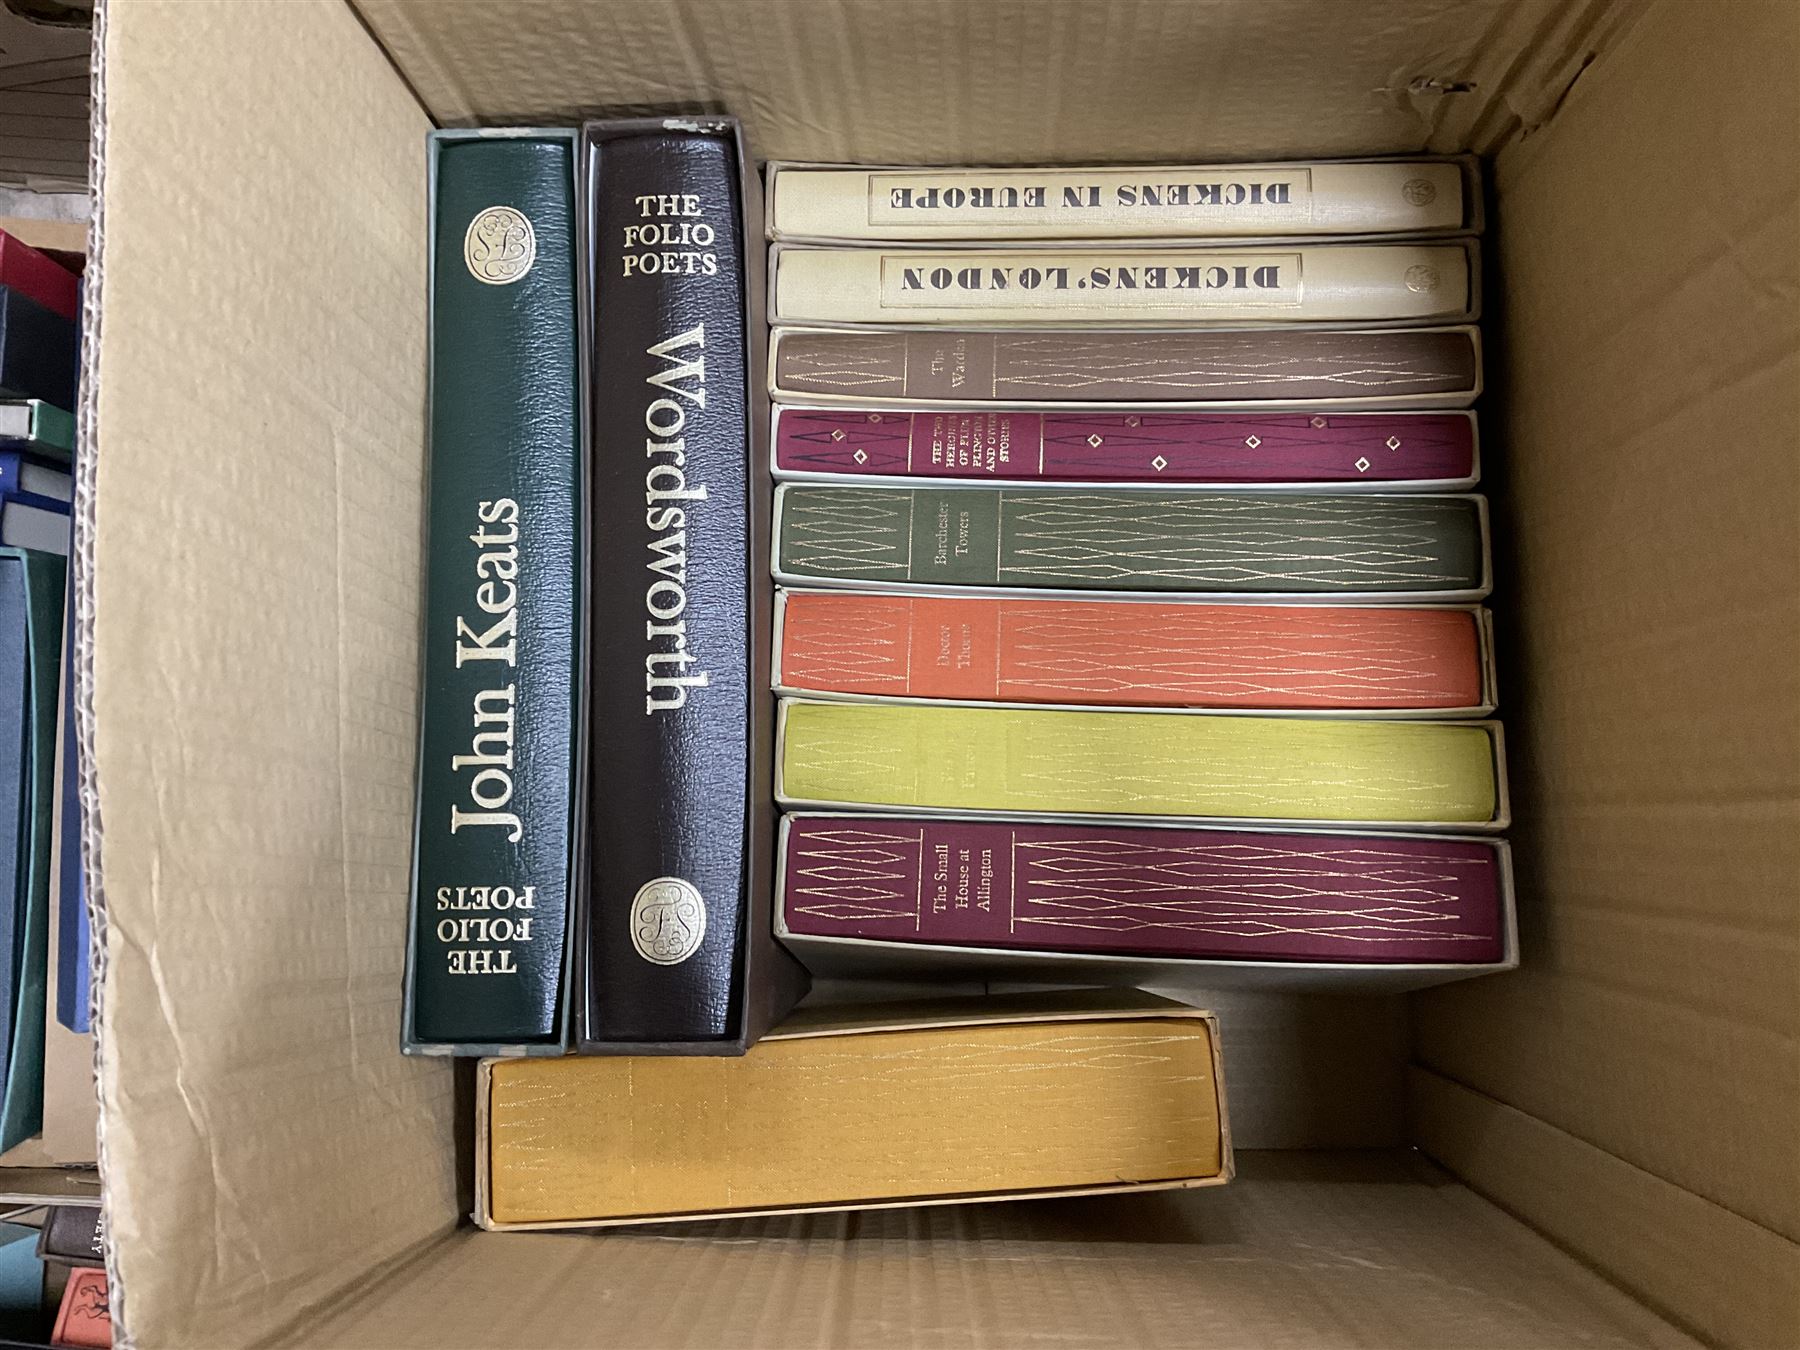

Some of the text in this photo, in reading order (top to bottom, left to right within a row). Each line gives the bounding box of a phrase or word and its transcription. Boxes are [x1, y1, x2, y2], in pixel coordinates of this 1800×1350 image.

[635, 194, 702, 218] THE
[890, 183, 1292, 209] DICKENS IN EUROPE
[623, 222, 715, 249] FOLIO
[622, 252, 718, 277] POETS
[901, 267, 1071, 290] LONDON
[931, 349, 945, 376] The
[932, 440, 942, 464] THE
[959, 449, 969, 466] OF
[985, 447, 996, 473] AND
[646, 322, 709, 717] Wordsworth
[934, 501, 949, 565] Barchester
[955, 511, 969, 557] Towers
[936, 625, 950, 666] Doctor
[450, 497, 522, 843] John Keats
[933, 844, 948, 914] The Small
[955, 849, 970, 909] House at
[977, 849, 994, 912] Allington
[437, 885, 536, 910] POETS
[437, 918, 534, 943] FOLIO
[448, 950, 517, 975] THE
